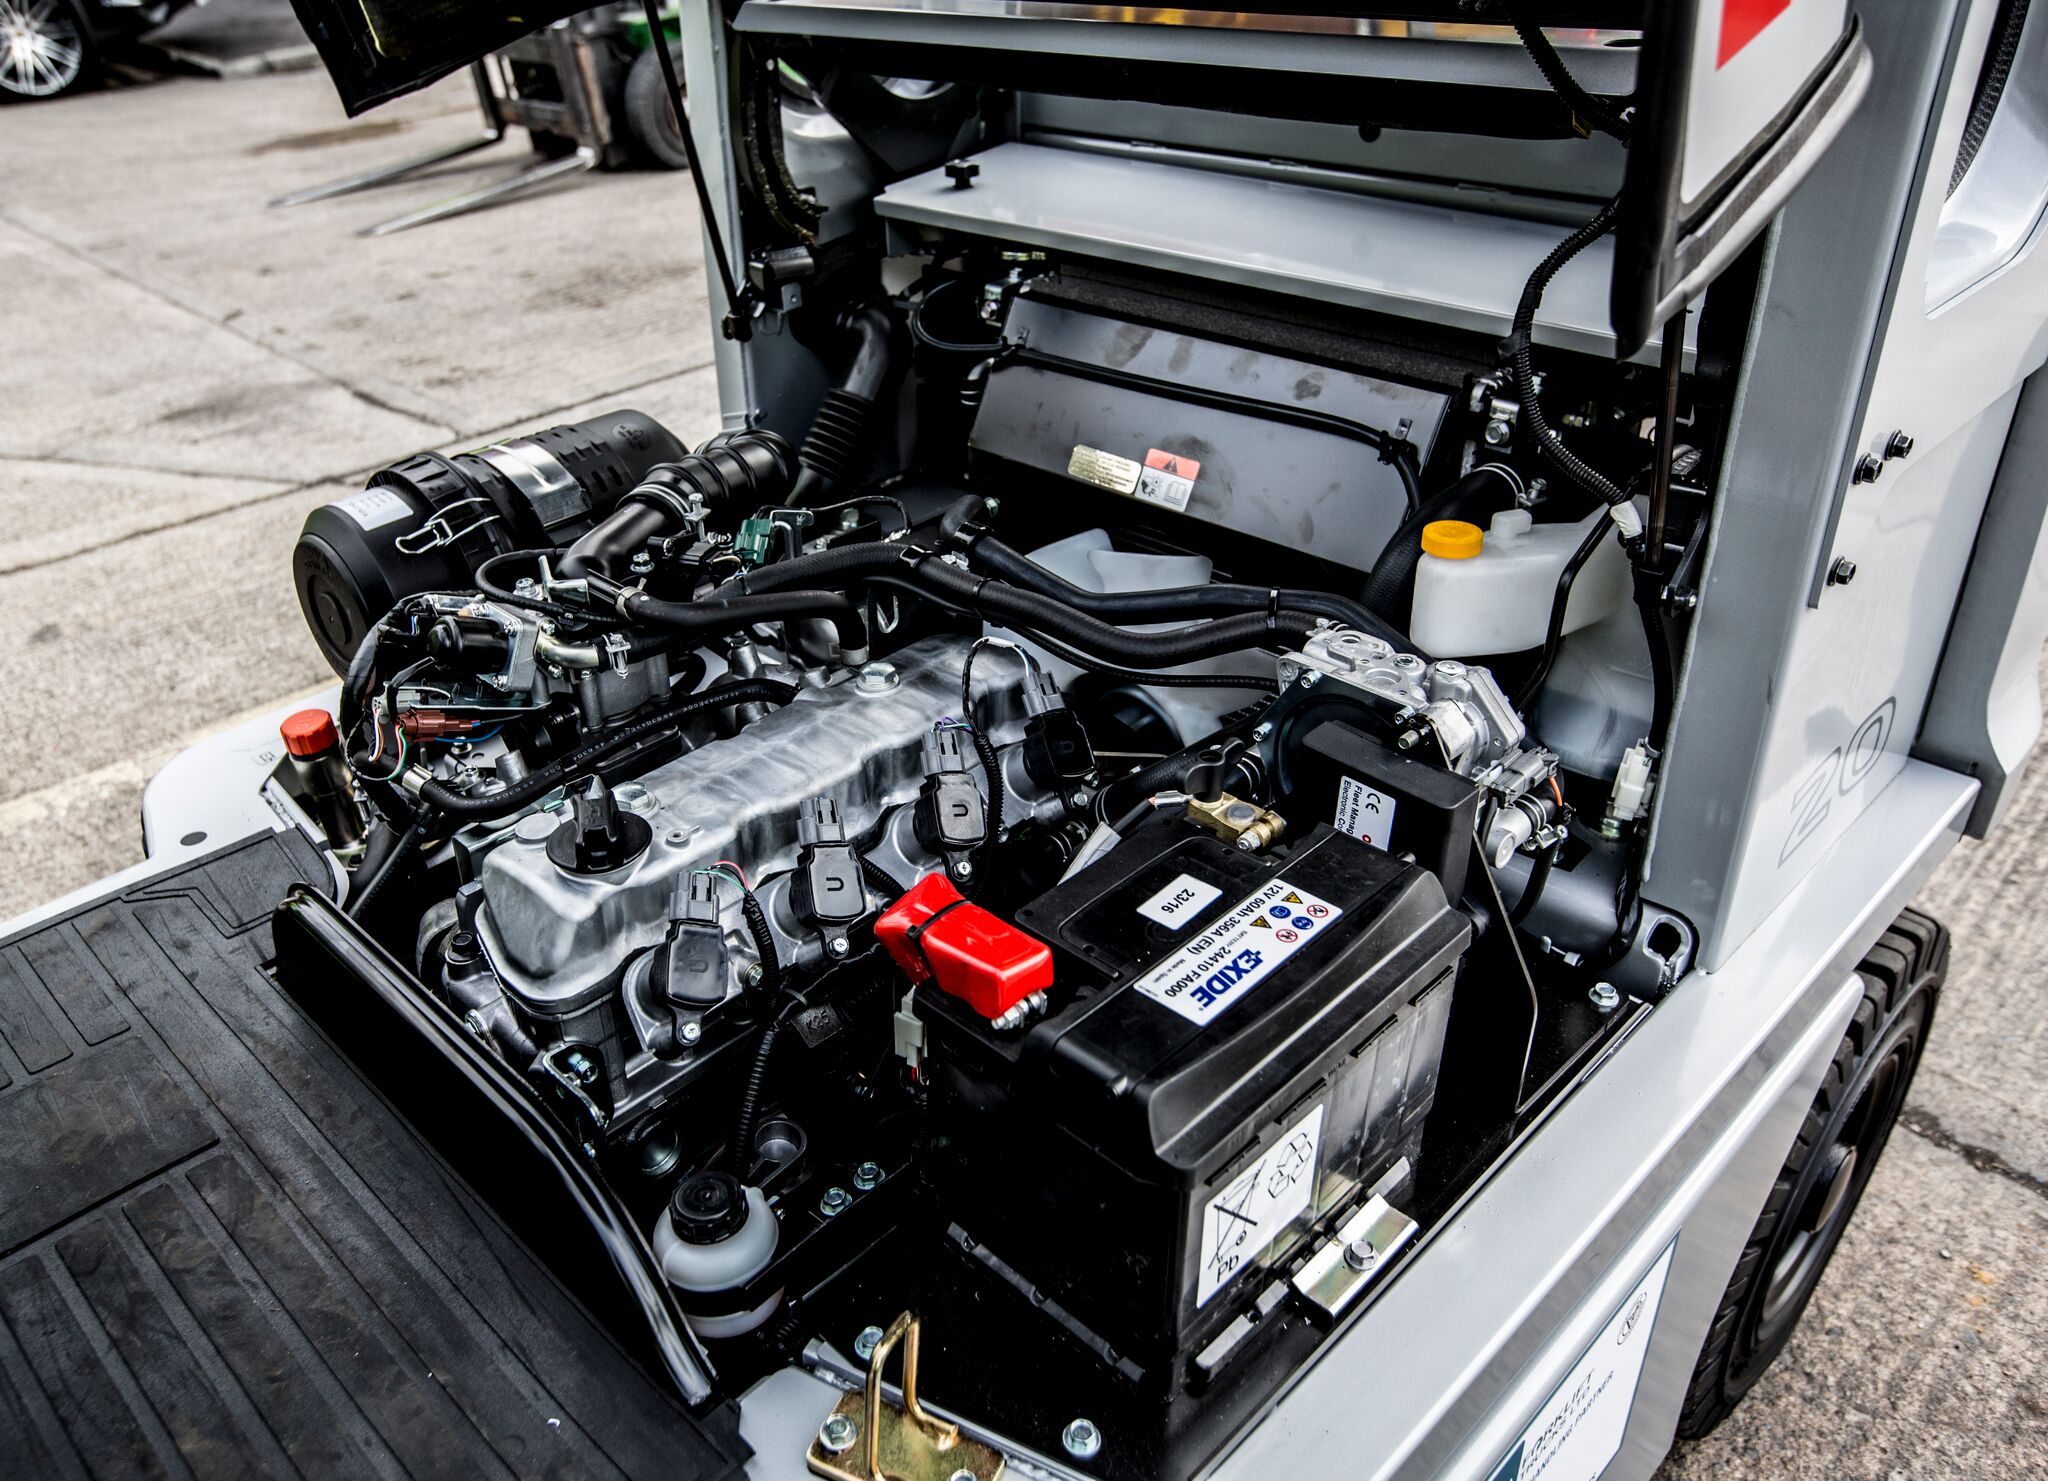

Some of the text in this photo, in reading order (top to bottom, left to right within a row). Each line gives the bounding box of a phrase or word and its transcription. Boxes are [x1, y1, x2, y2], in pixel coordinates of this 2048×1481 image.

[1339, 780, 1352, 817] Electronic
[1352, 785, 1363, 807] Fleet
[1777, 695, 1897, 869] 20
[1365, 793, 1381, 814] CE
[1161, 888, 1196, 914] 23/16
[1186, 884, 1284, 955] 12V 60Ah 356A (EN)
[1174, 957, 1186, 968] Made
[1197, 946, 1232, 972] 24410
[1164, 969, 1202, 997] FA000
[1190, 948, 1264, 1008] EXIDE
[1216, 1254, 1239, 1283] Pb
[1574, 1369, 1614, 1428] PARTNER
[1522, 1367, 1596, 1469] FORKLIFT
[1520, 1415, 1567, 1480] TRUCKS
